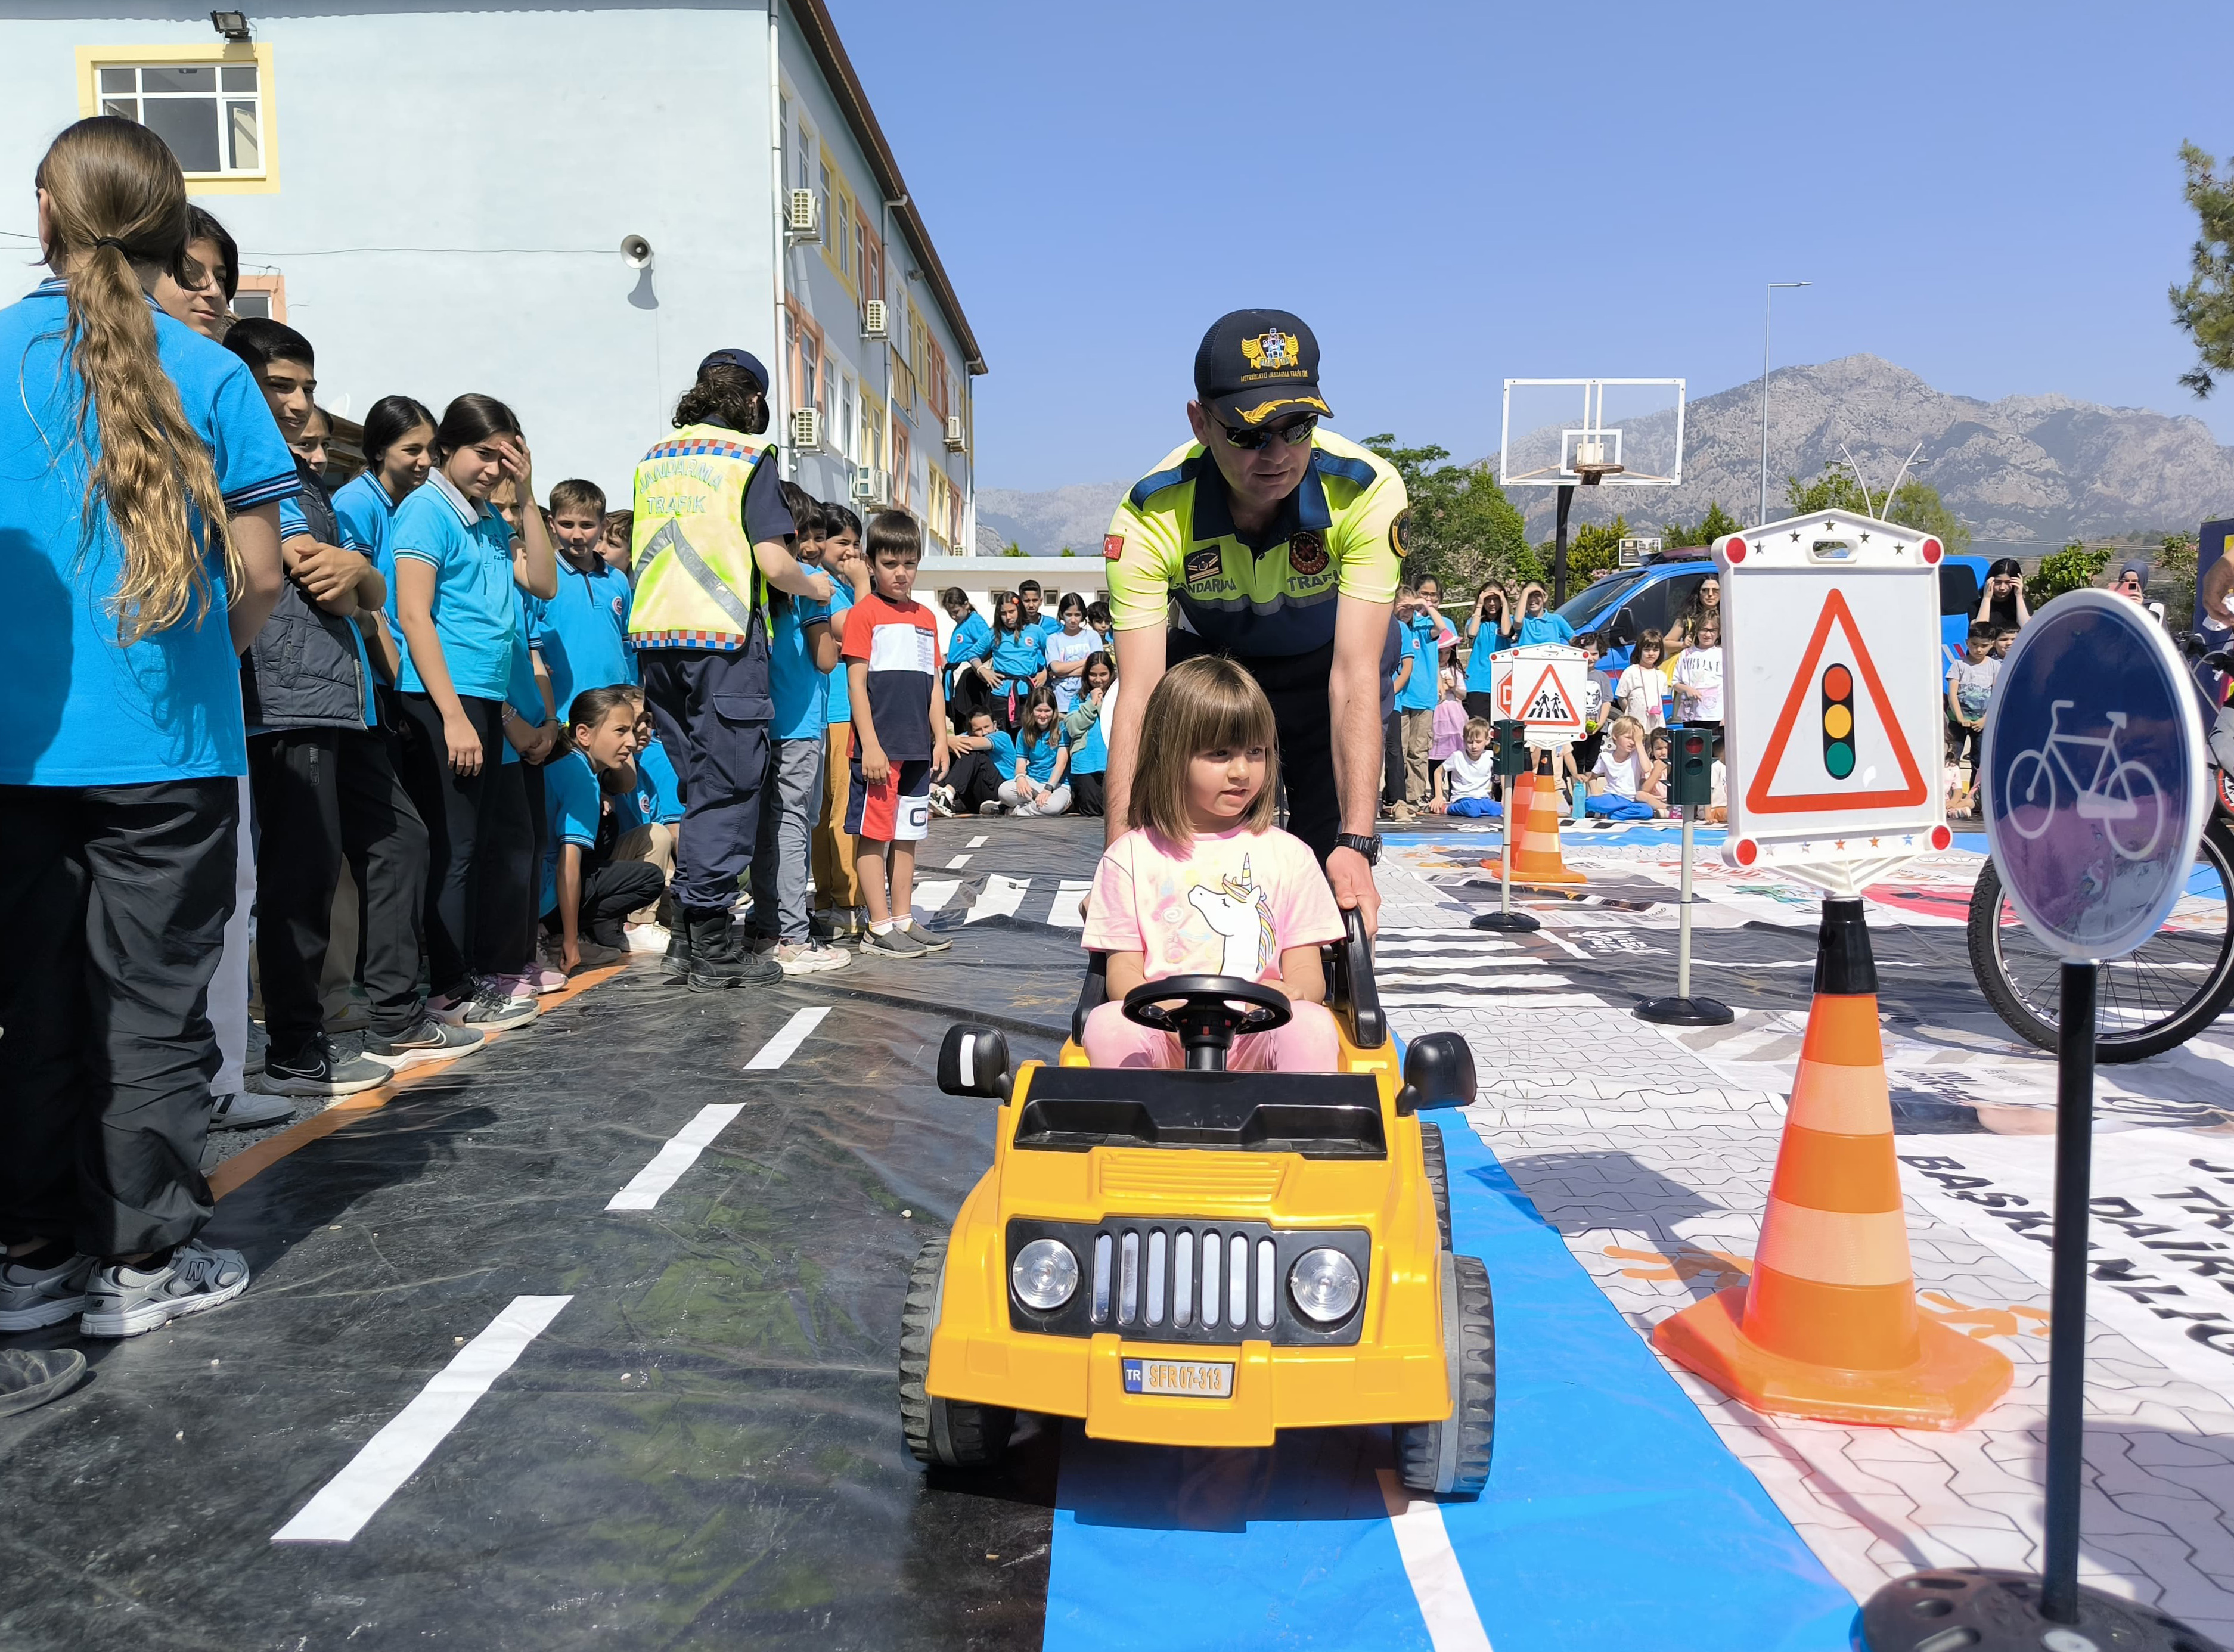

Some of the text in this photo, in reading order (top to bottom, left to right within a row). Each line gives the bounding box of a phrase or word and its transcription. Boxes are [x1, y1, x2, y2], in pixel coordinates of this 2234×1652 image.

[639, 458, 724, 494] JANDARMA
[646, 495, 706, 514] TRAFİK
[1286, 569, 1339, 592] TRAFİ
[1125, 1368, 1141, 1381] TR
